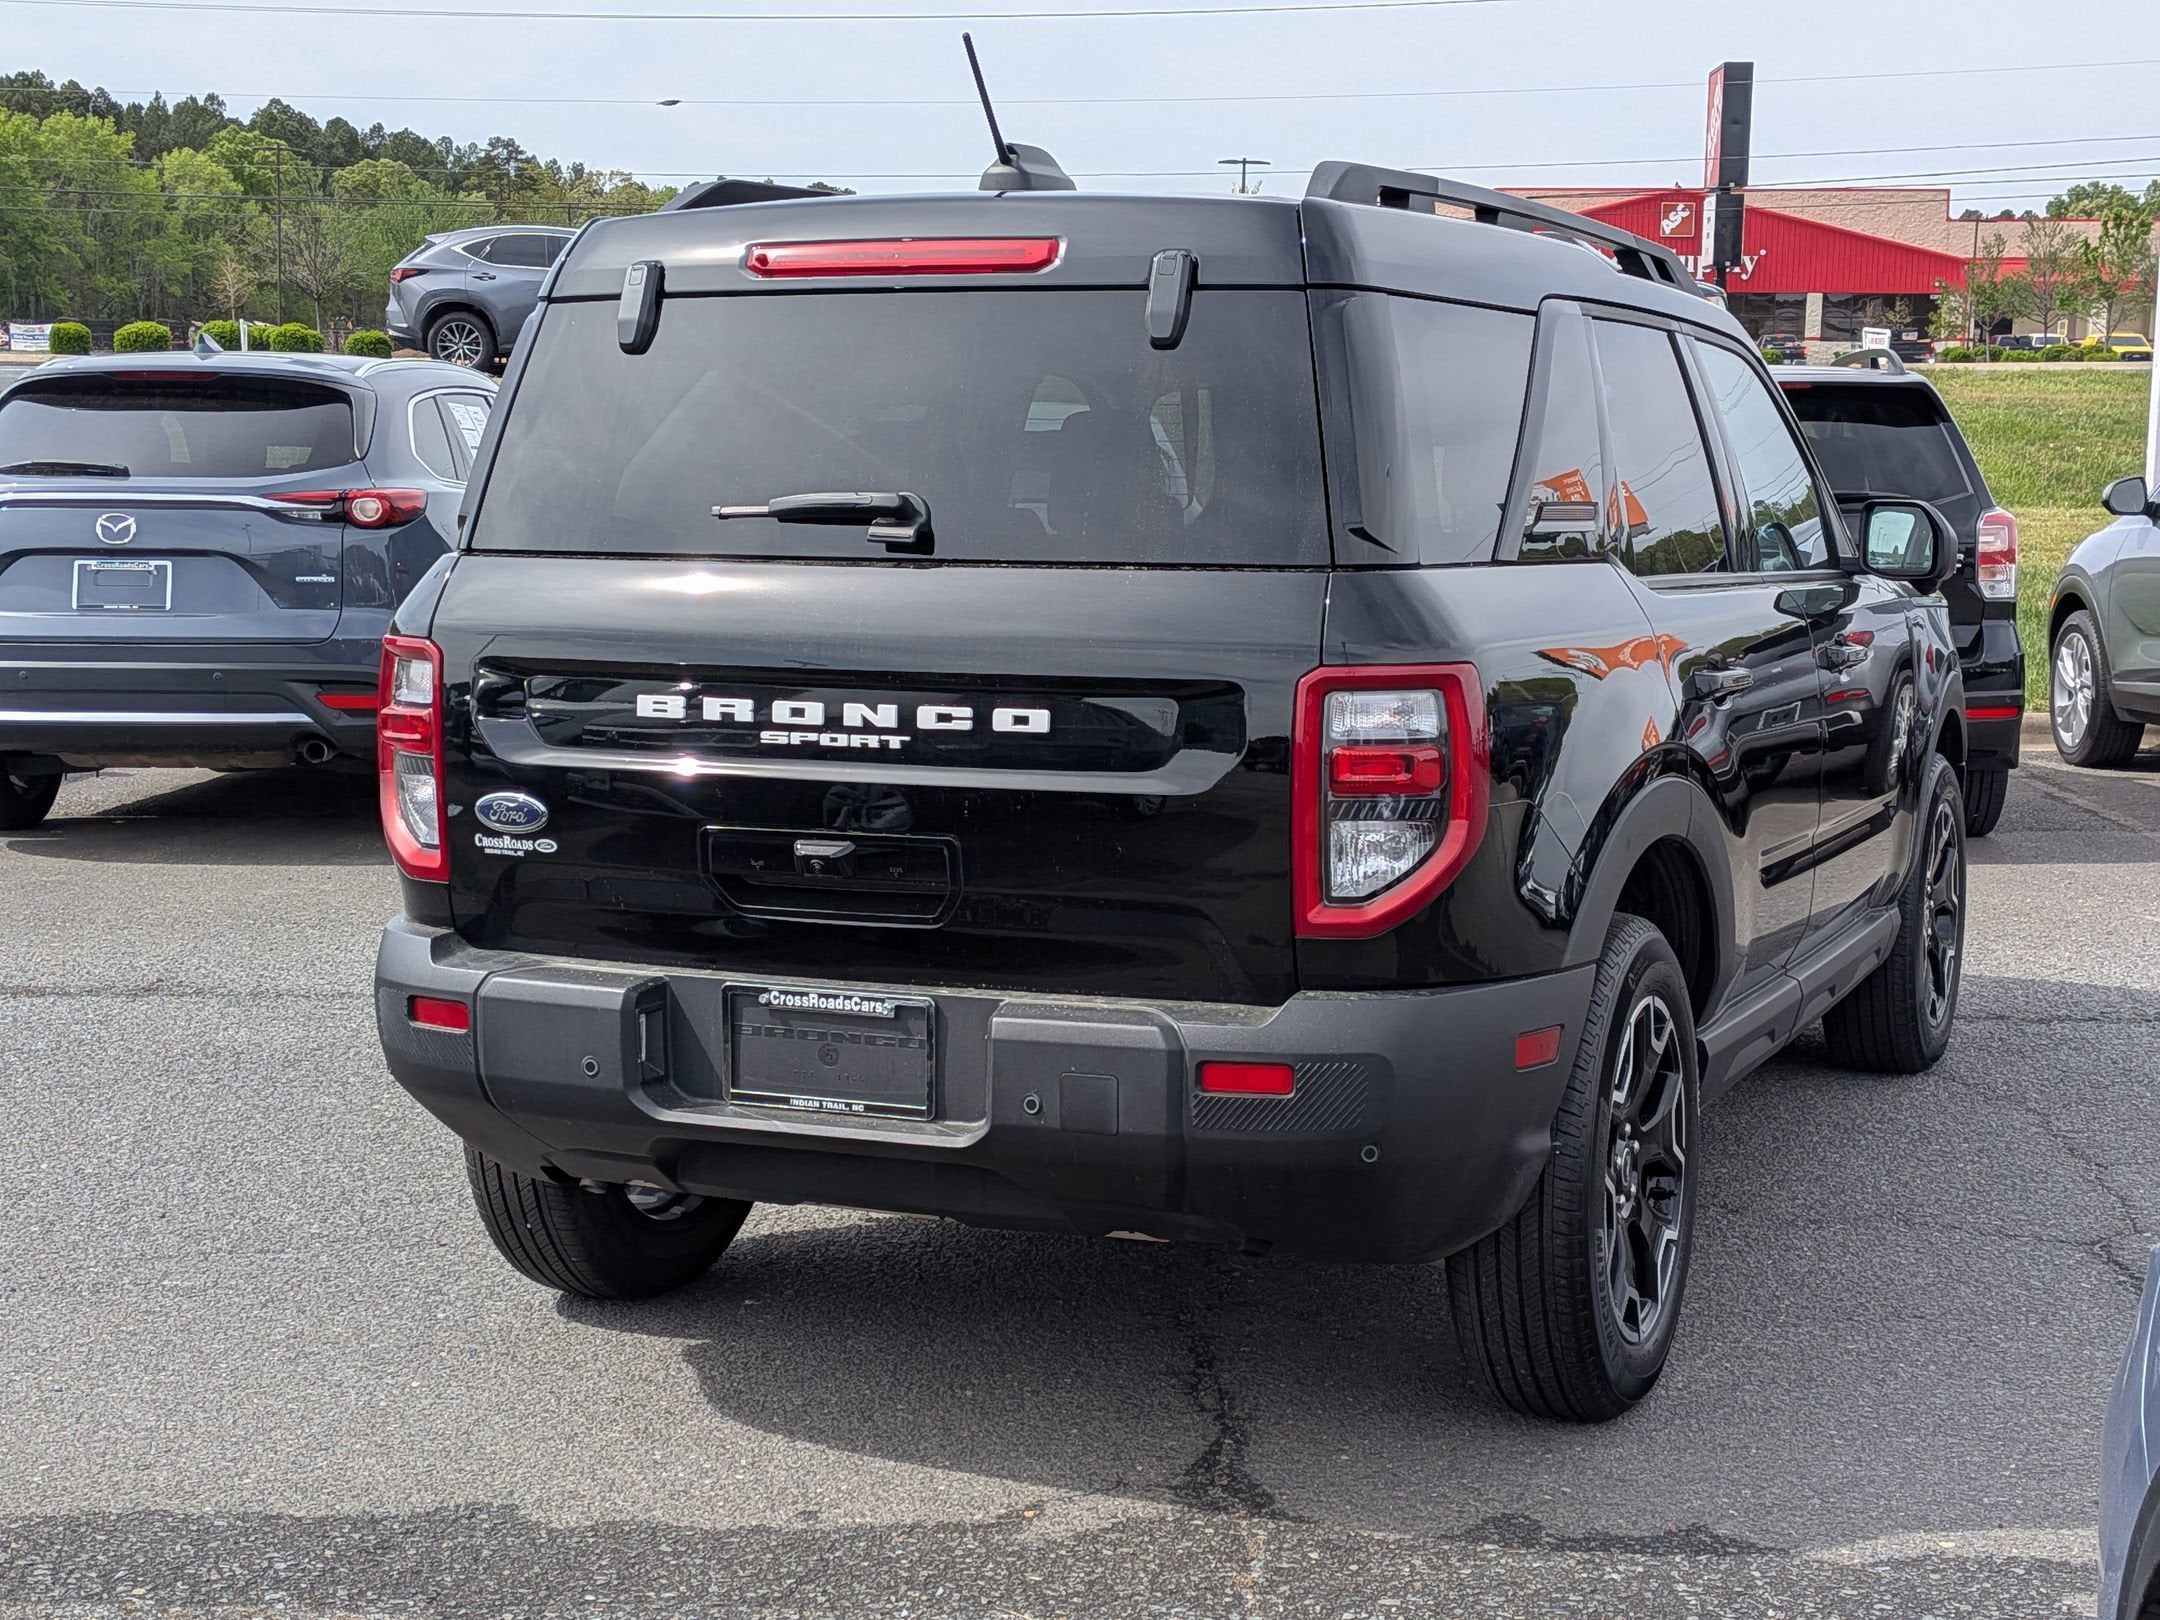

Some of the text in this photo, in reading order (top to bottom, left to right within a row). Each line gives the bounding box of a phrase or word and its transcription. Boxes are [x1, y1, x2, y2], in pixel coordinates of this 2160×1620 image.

[636, 694, 1051, 733] BRONCO
[759, 731, 911, 749] SPORT
[489, 800, 528, 823] Ford
[769, 990, 883, 1014] CrossRoadsCars
[731, 1022, 927, 1050] BRONCO
[789, 1098, 820, 1109] INDIAN
[851, 1104, 865, 1113] NC
